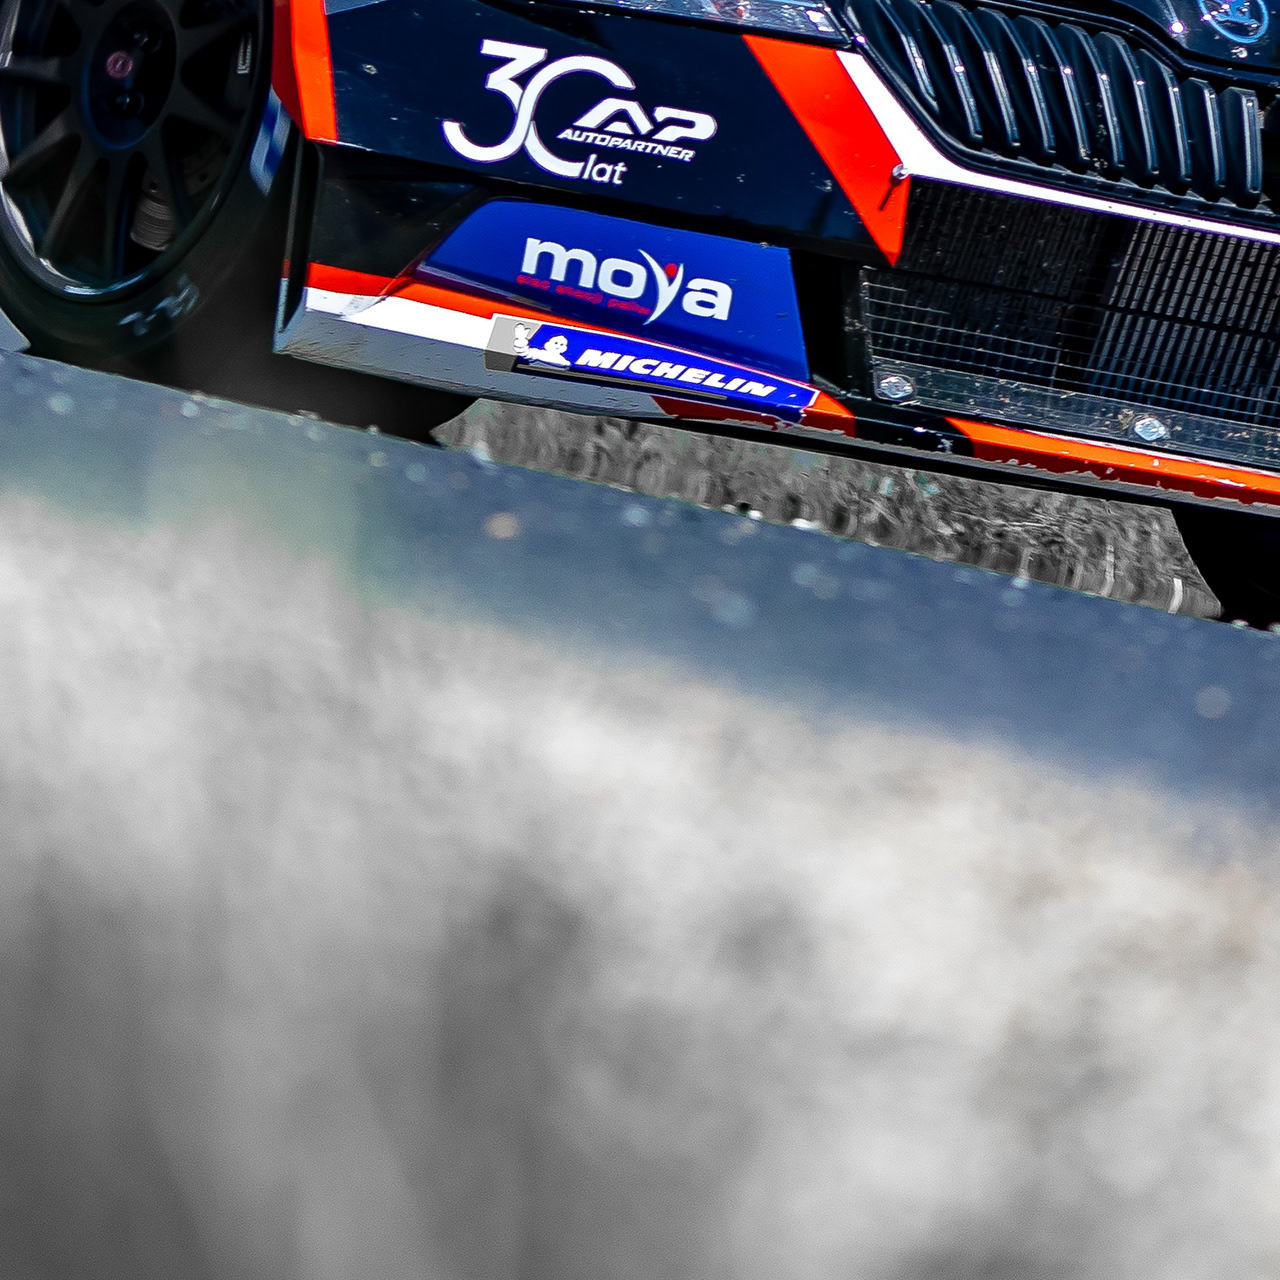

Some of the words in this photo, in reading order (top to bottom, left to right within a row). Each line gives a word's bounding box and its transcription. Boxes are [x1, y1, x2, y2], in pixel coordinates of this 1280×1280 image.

[556, 127, 697, 162] AUTOPARTNER
[581, 153, 628, 186] lat
[520, 236, 734, 326] moya
[573, 348, 778, 398] MICHELIN
